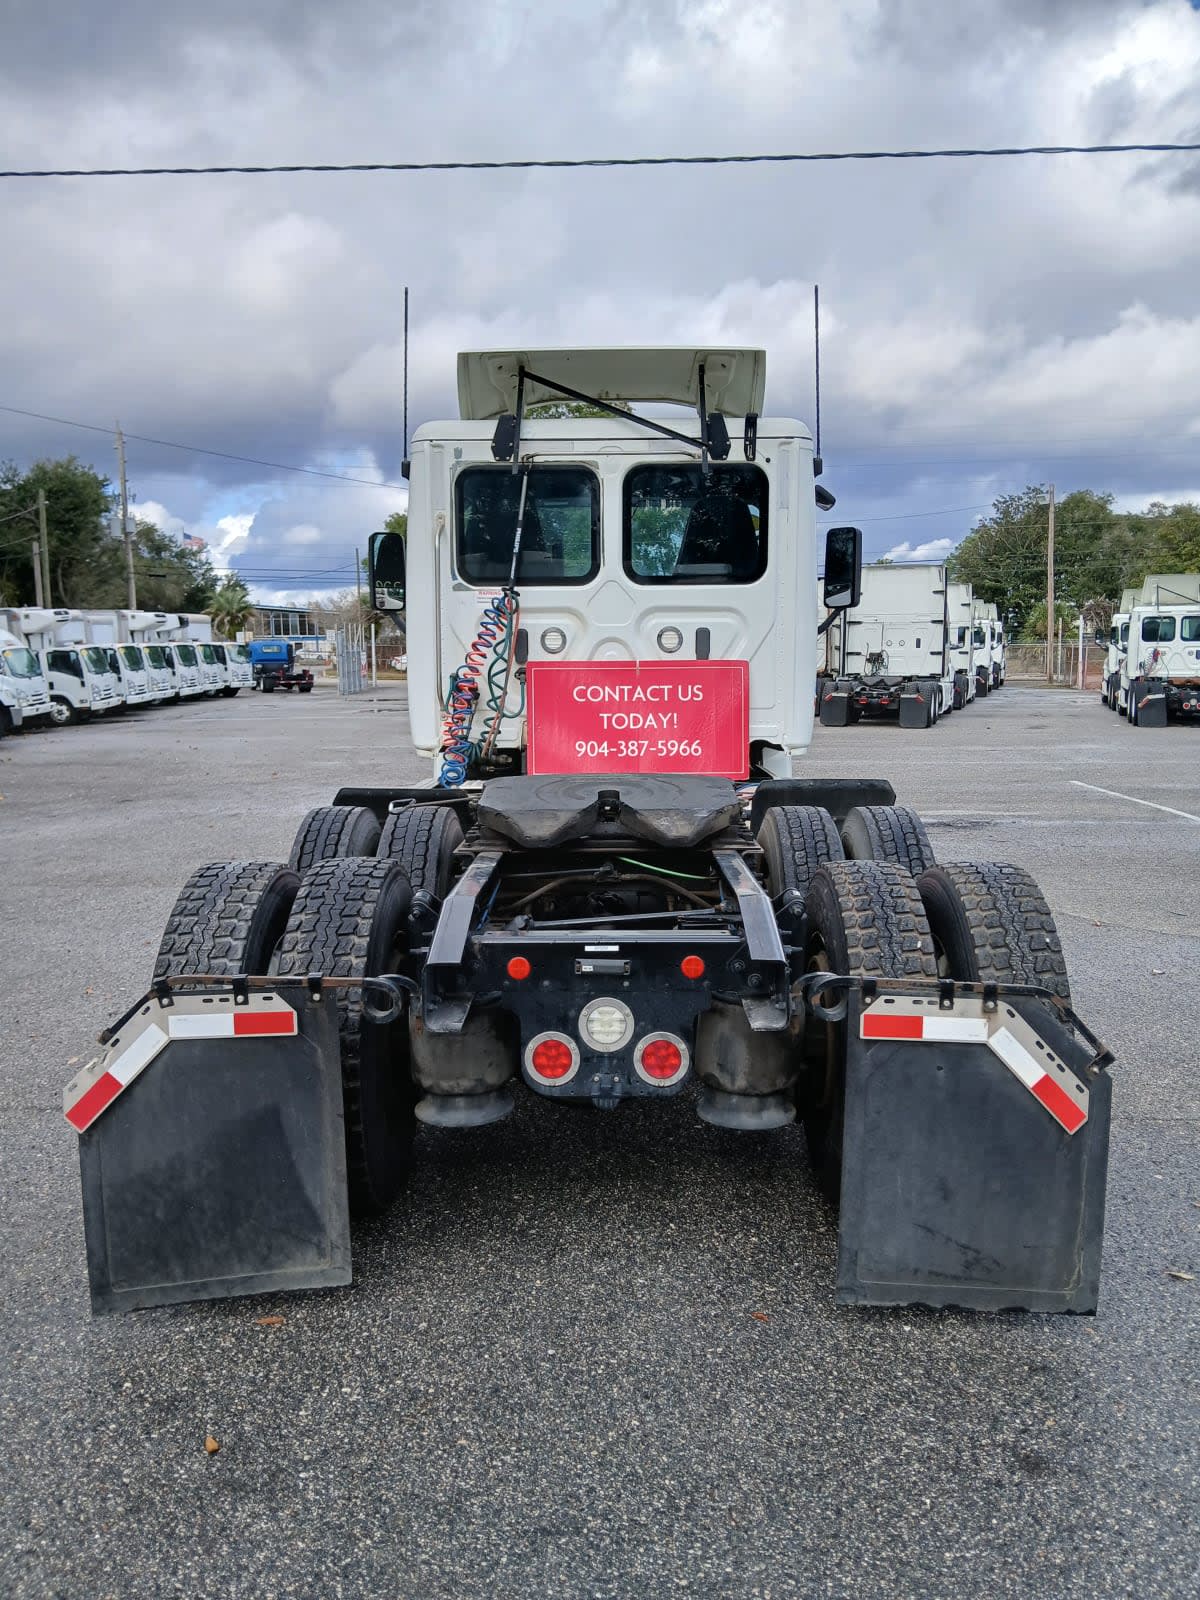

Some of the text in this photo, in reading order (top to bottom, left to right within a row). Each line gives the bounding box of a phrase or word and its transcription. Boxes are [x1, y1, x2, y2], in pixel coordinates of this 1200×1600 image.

[572, 684, 704, 702] CONTACT US
[599, 712, 678, 730] TODAY!
[575, 740, 702, 757] 904-387-5966
